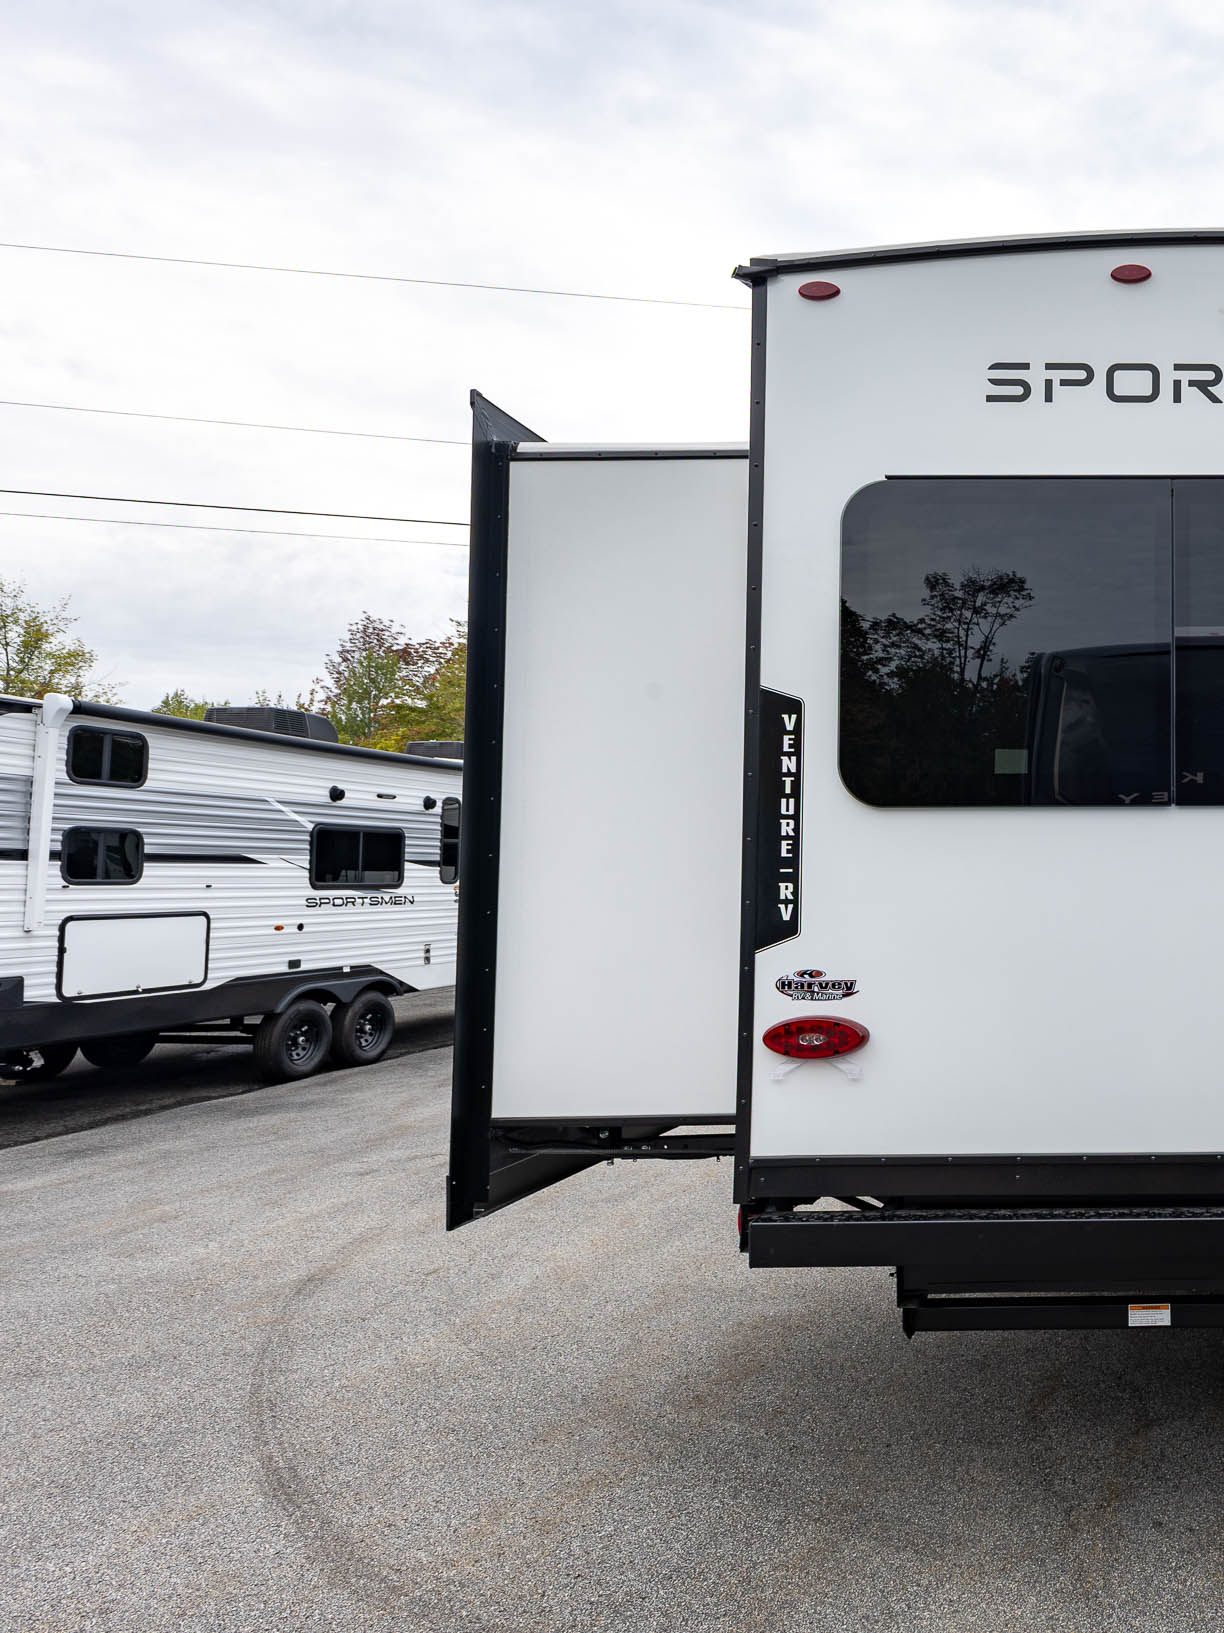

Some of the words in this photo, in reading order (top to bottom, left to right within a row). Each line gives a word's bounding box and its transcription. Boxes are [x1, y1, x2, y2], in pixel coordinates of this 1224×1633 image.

[305, 896, 415, 908] SPORTSMEN
[780, 979, 856, 993] Harvey
[791, 992, 804, 1000] RV
[805, 992, 812, 1000] &
[813, 992, 842, 1000] Marine
